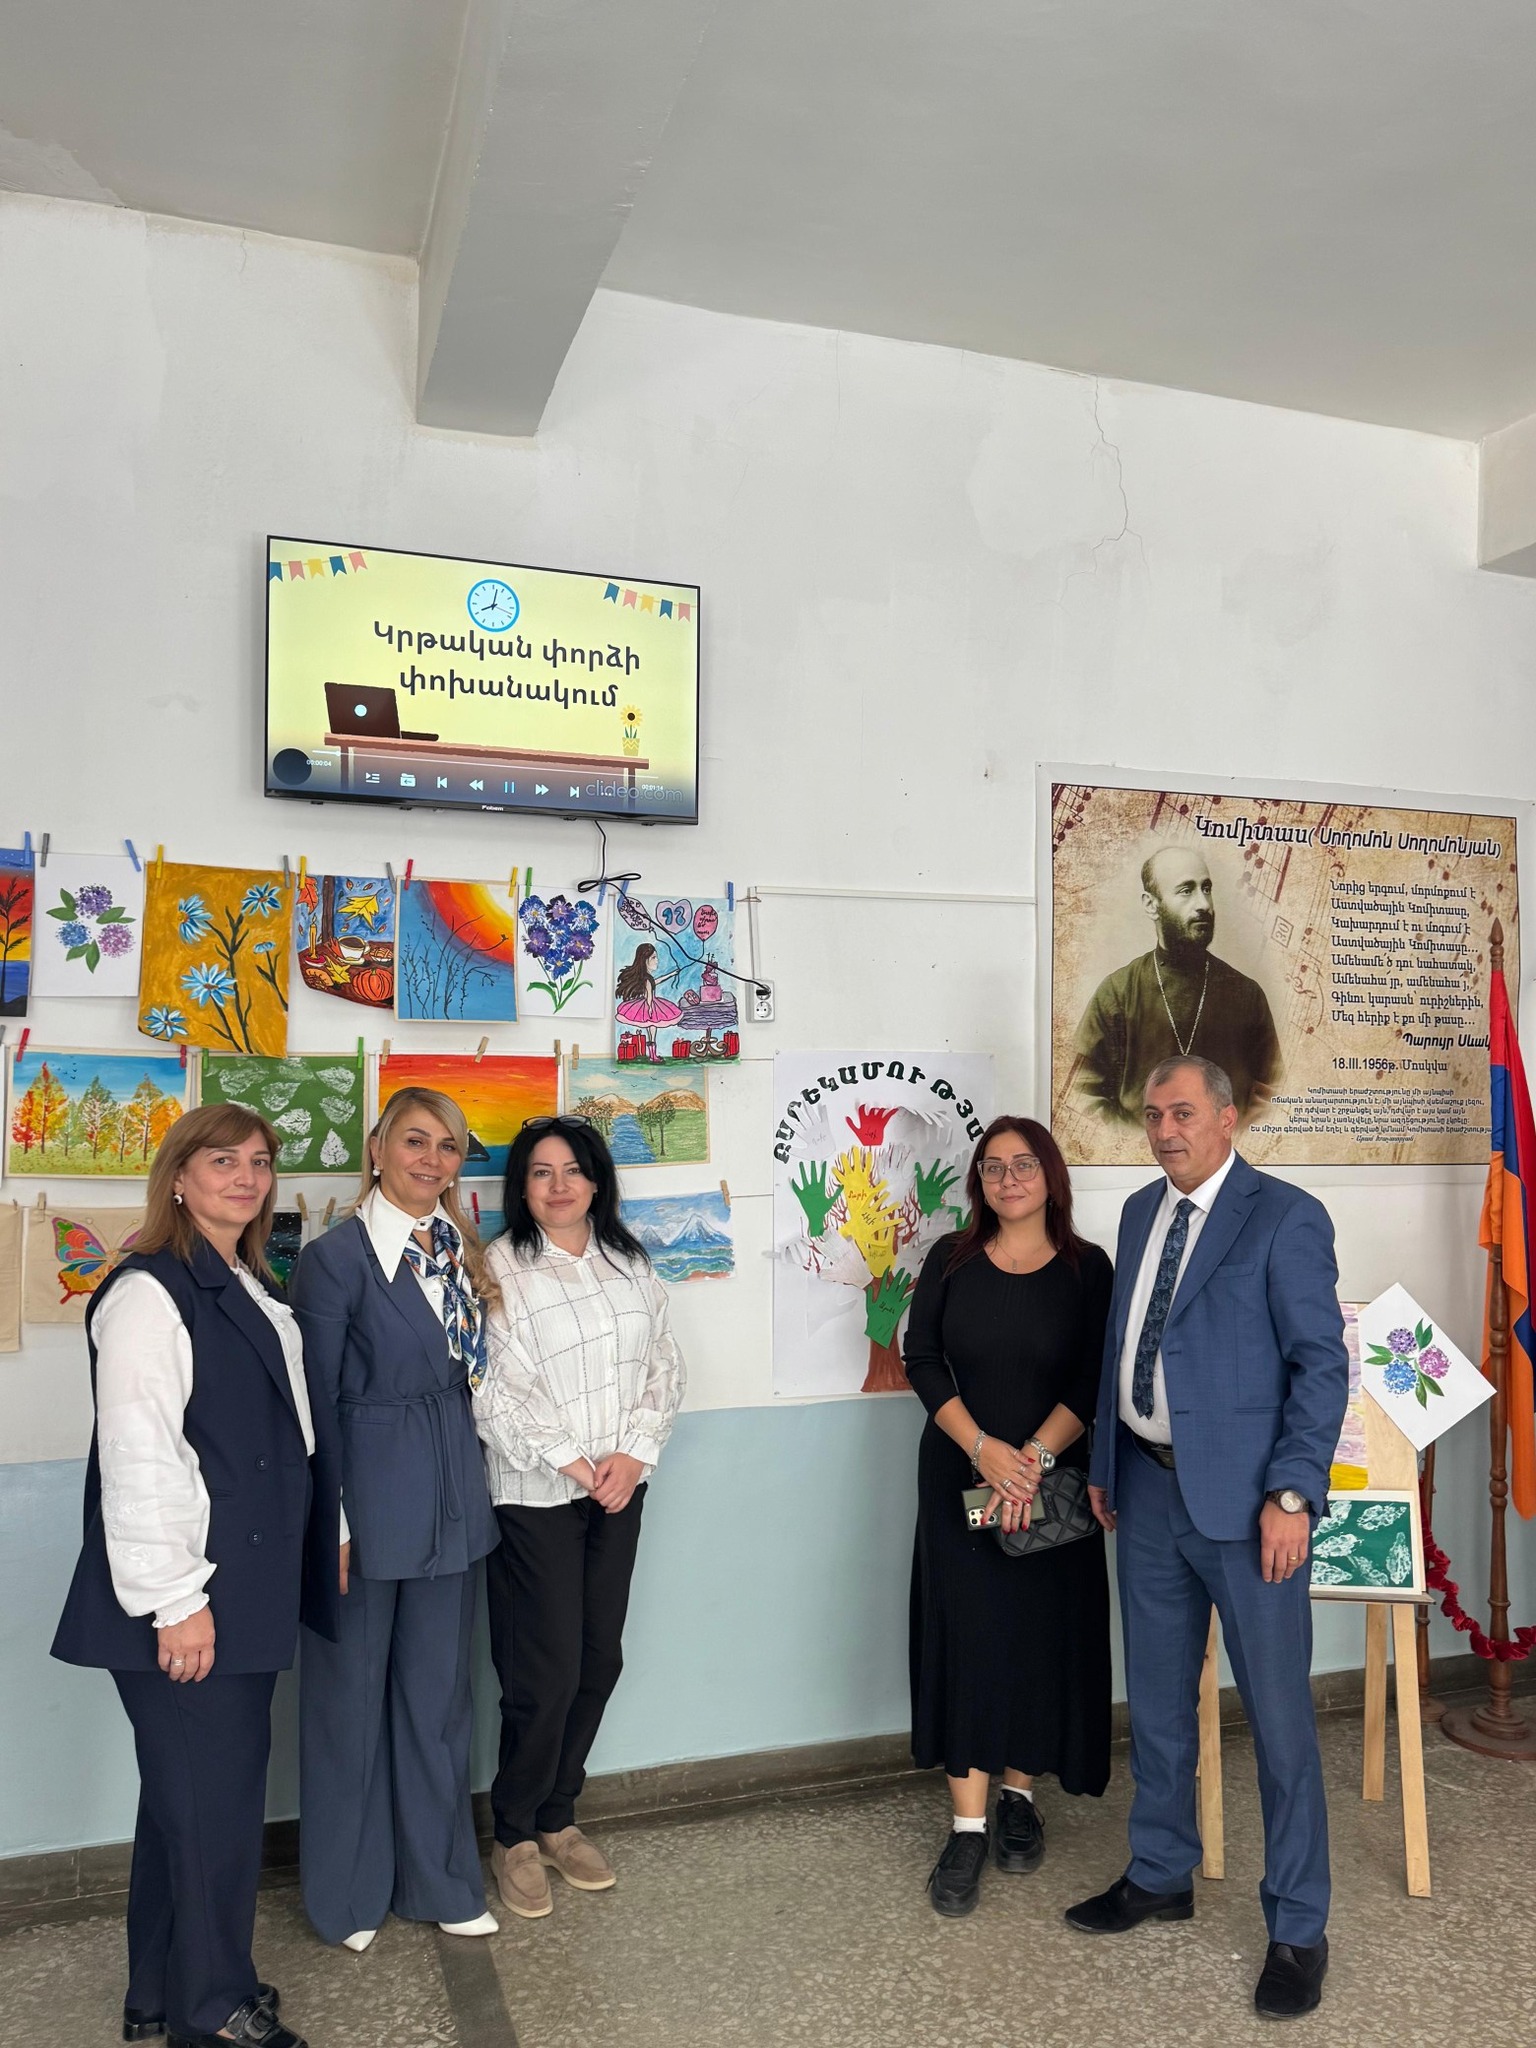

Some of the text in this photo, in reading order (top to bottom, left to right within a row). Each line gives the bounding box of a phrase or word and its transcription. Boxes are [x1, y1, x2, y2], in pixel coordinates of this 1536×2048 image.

[374, 620, 641, 675] Կրթական փորձի
[400, 665, 617, 709] փոխանակում
[306, 759, 332, 767] 00:00:04
[585, 779, 683, 803] clideo.com
[1320, 828, 1392, 850] Սողոմոն
[1398, 832, 1501, 858] Սողոմոնյան)
[1330, 879, 1476, 900] Նորից երգում, մորմոքում է
[1331, 898, 1470, 919] Աստվածային Կոմիտասը,
[1331, 917, 1471, 936] Կախարդում է ու մոգում է
[1331, 935, 1406, 952] Աստվածային
[1395, 960, 1414, 971] դու
[1417, 957, 1476, 974] նահատակ,
[1332, 991, 1365, 1005] Գինու
[1419, 994, 1484, 1010] ուրիշներին,
[1332, 1010, 1354, 1026] Մեզ
[1357, 1011, 1390, 1026] հերիք
[1393, 1012, 1399, 1023] է
[1402, 1015, 1415, 1027] քո
[1418, 1013, 1431, 1027] մի
[1402, 1033, 1453, 1051] Պարույր
[1332, 1058, 1448, 1073] 18.III.1956թ. Մոսկվա
[1308, 1087, 1347, 1095] Կոմիտասի
[1349, 1087, 1411, 1096] երաժշտությունը
[1413, 1088, 1421, 1096] մի
